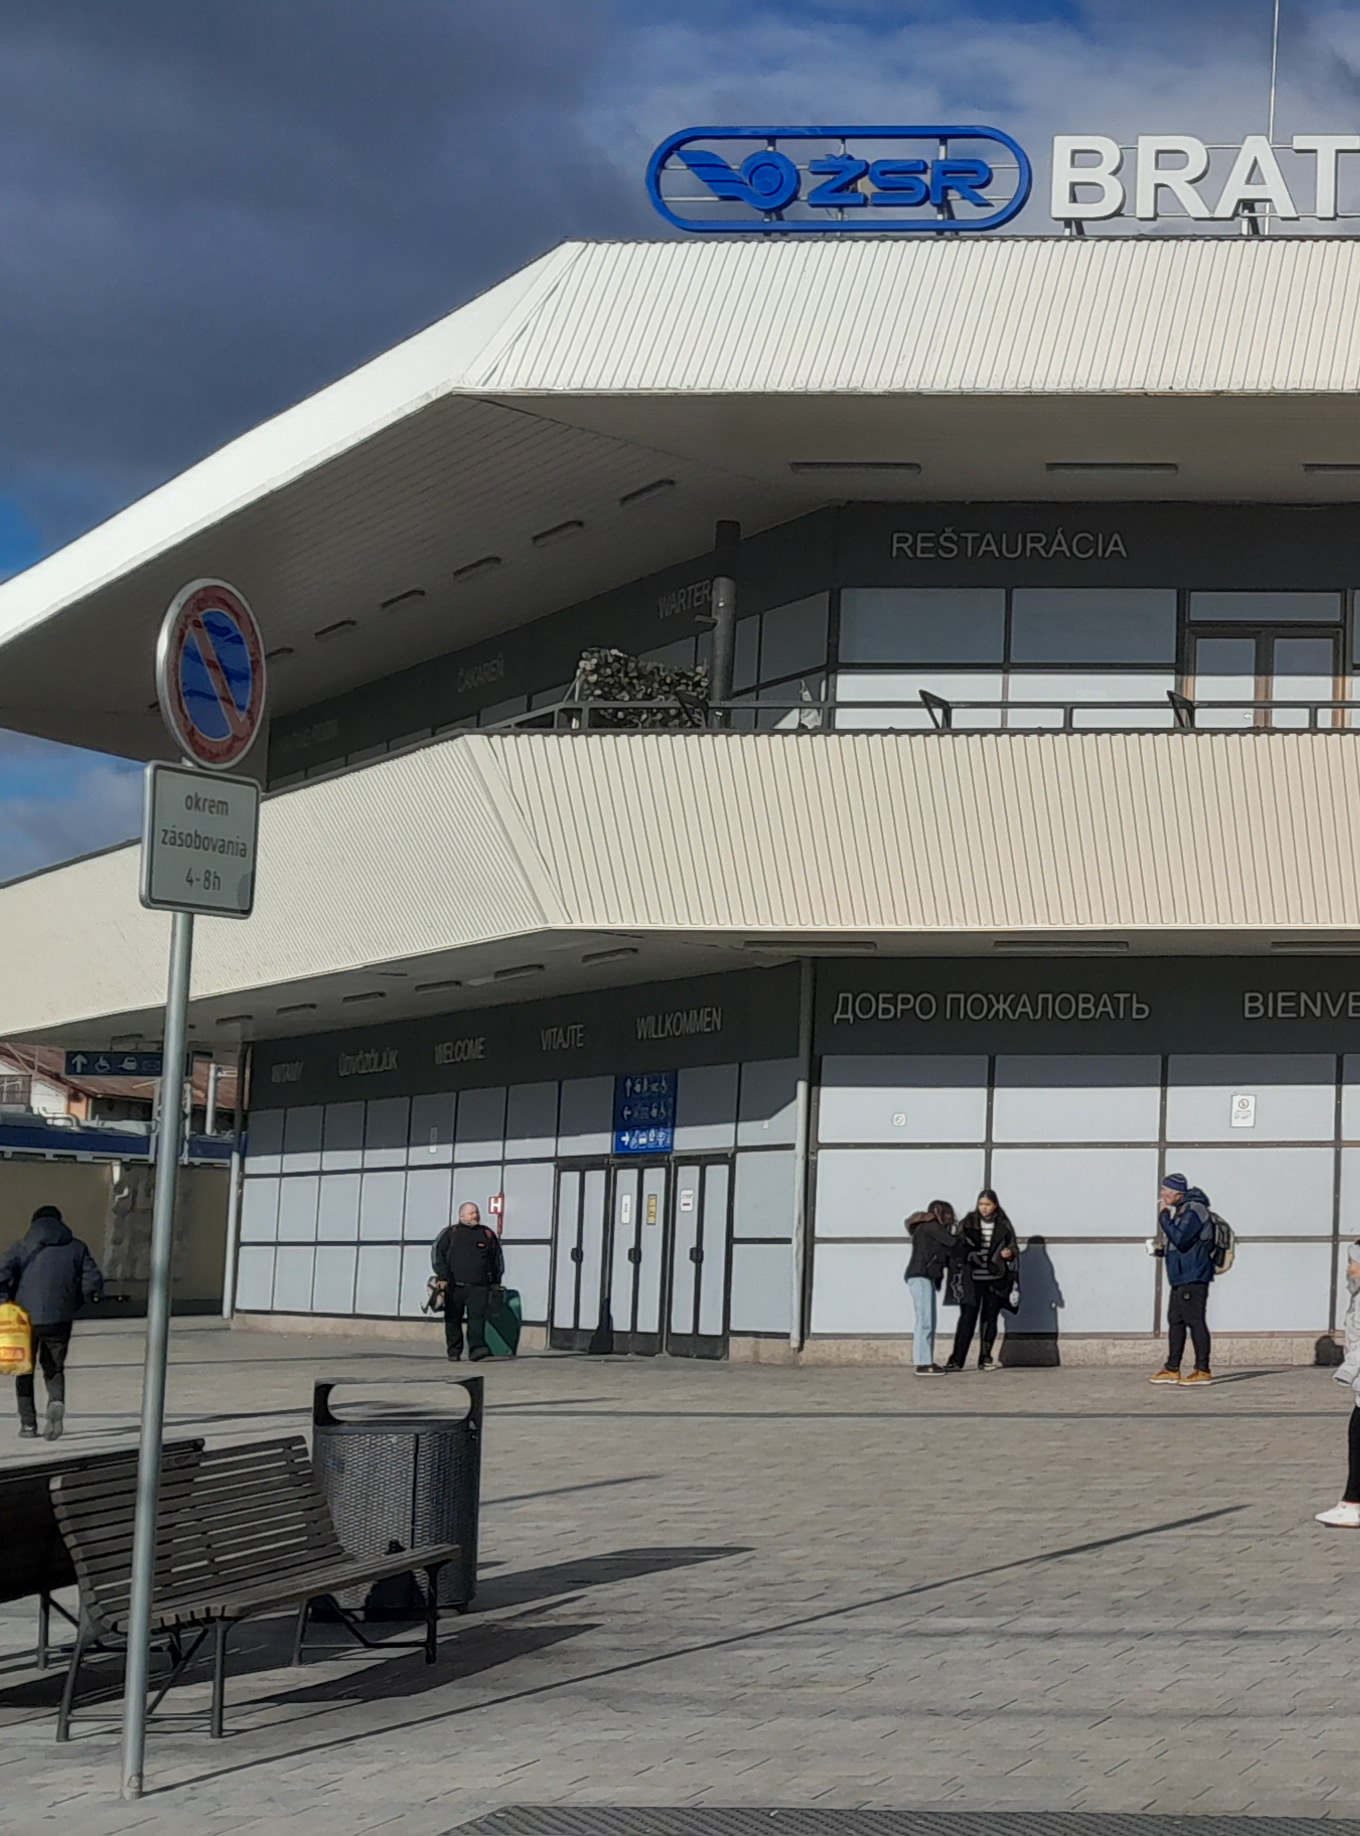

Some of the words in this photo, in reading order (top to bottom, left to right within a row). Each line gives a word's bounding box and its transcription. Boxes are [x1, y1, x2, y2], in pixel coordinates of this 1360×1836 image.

[890, 526, 1128, 561] REŠTAURÁCIA
[658, 579, 712, 619] WARTER
[184, 792, 229, 817] okrem
[160, 824, 247, 858] zásobovania
[636, 1006, 722, 1040] WILLKOMMEN
[833, 992, 937, 1024] ДОБРО
[945, 992, 1150, 1022] ПОЖАЛОВАТЬ
[434, 1036, 486, 1065] WELCOME
[540, 1023, 585, 1050] VITAJTE
